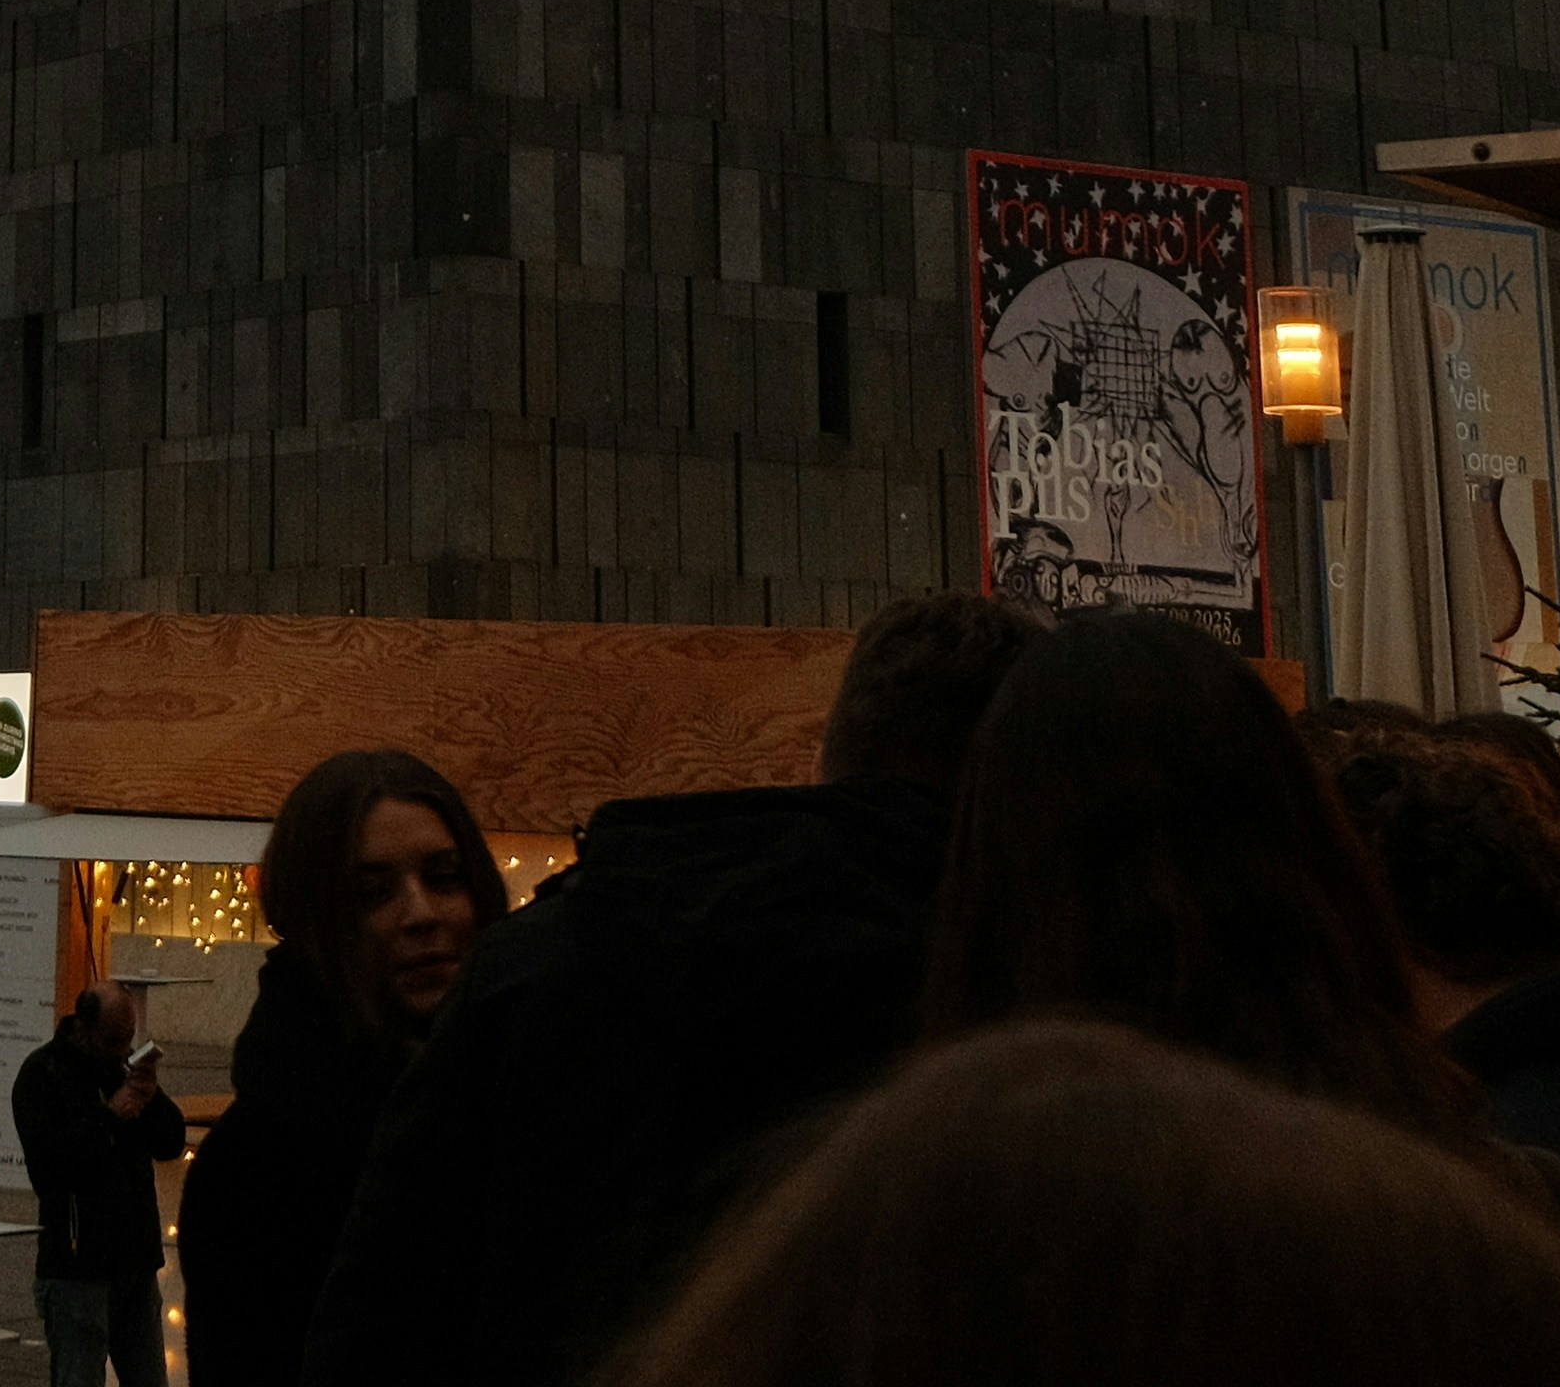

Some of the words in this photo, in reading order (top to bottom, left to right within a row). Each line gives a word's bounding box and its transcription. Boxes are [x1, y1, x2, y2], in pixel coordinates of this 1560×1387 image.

[997, 196, 1227, 269] mumok
[988, 400, 1163, 488] Tobias
[1462, 452, 1527, 480] orgen
